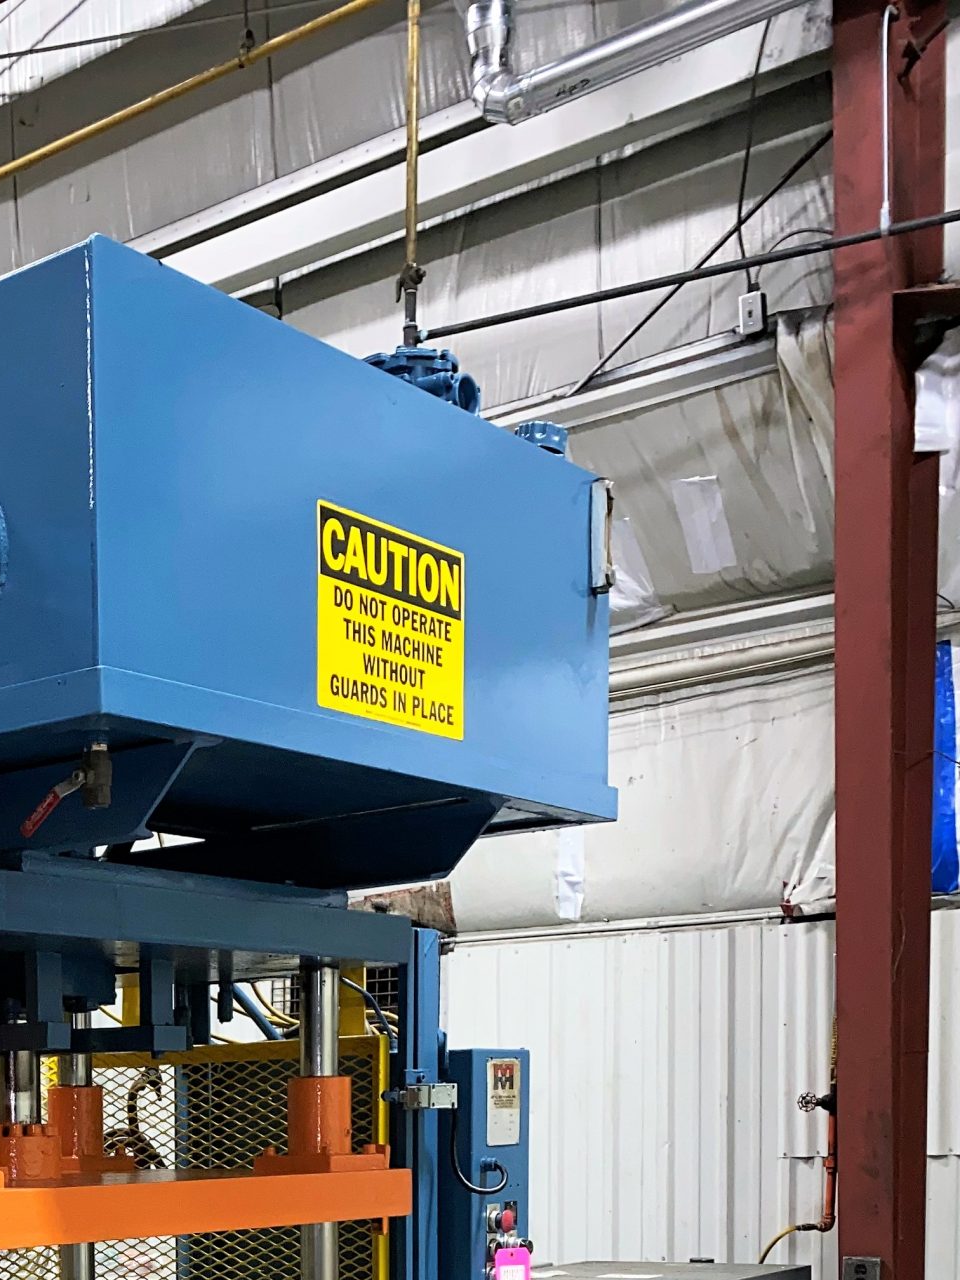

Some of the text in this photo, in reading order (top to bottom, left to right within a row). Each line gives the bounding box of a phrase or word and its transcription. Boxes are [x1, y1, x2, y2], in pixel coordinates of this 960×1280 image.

[322, 517, 460, 612] CAUTION
[334, 585, 452, 642] DO NOT OPERATE
[343, 618, 443, 668] THIS MACHINE
[363, 654, 425, 690] WITHOUT
[330, 674, 387, 708] GUARDS
[393, 690, 406, 714] IN
[413, 695, 454, 726] PLACE
